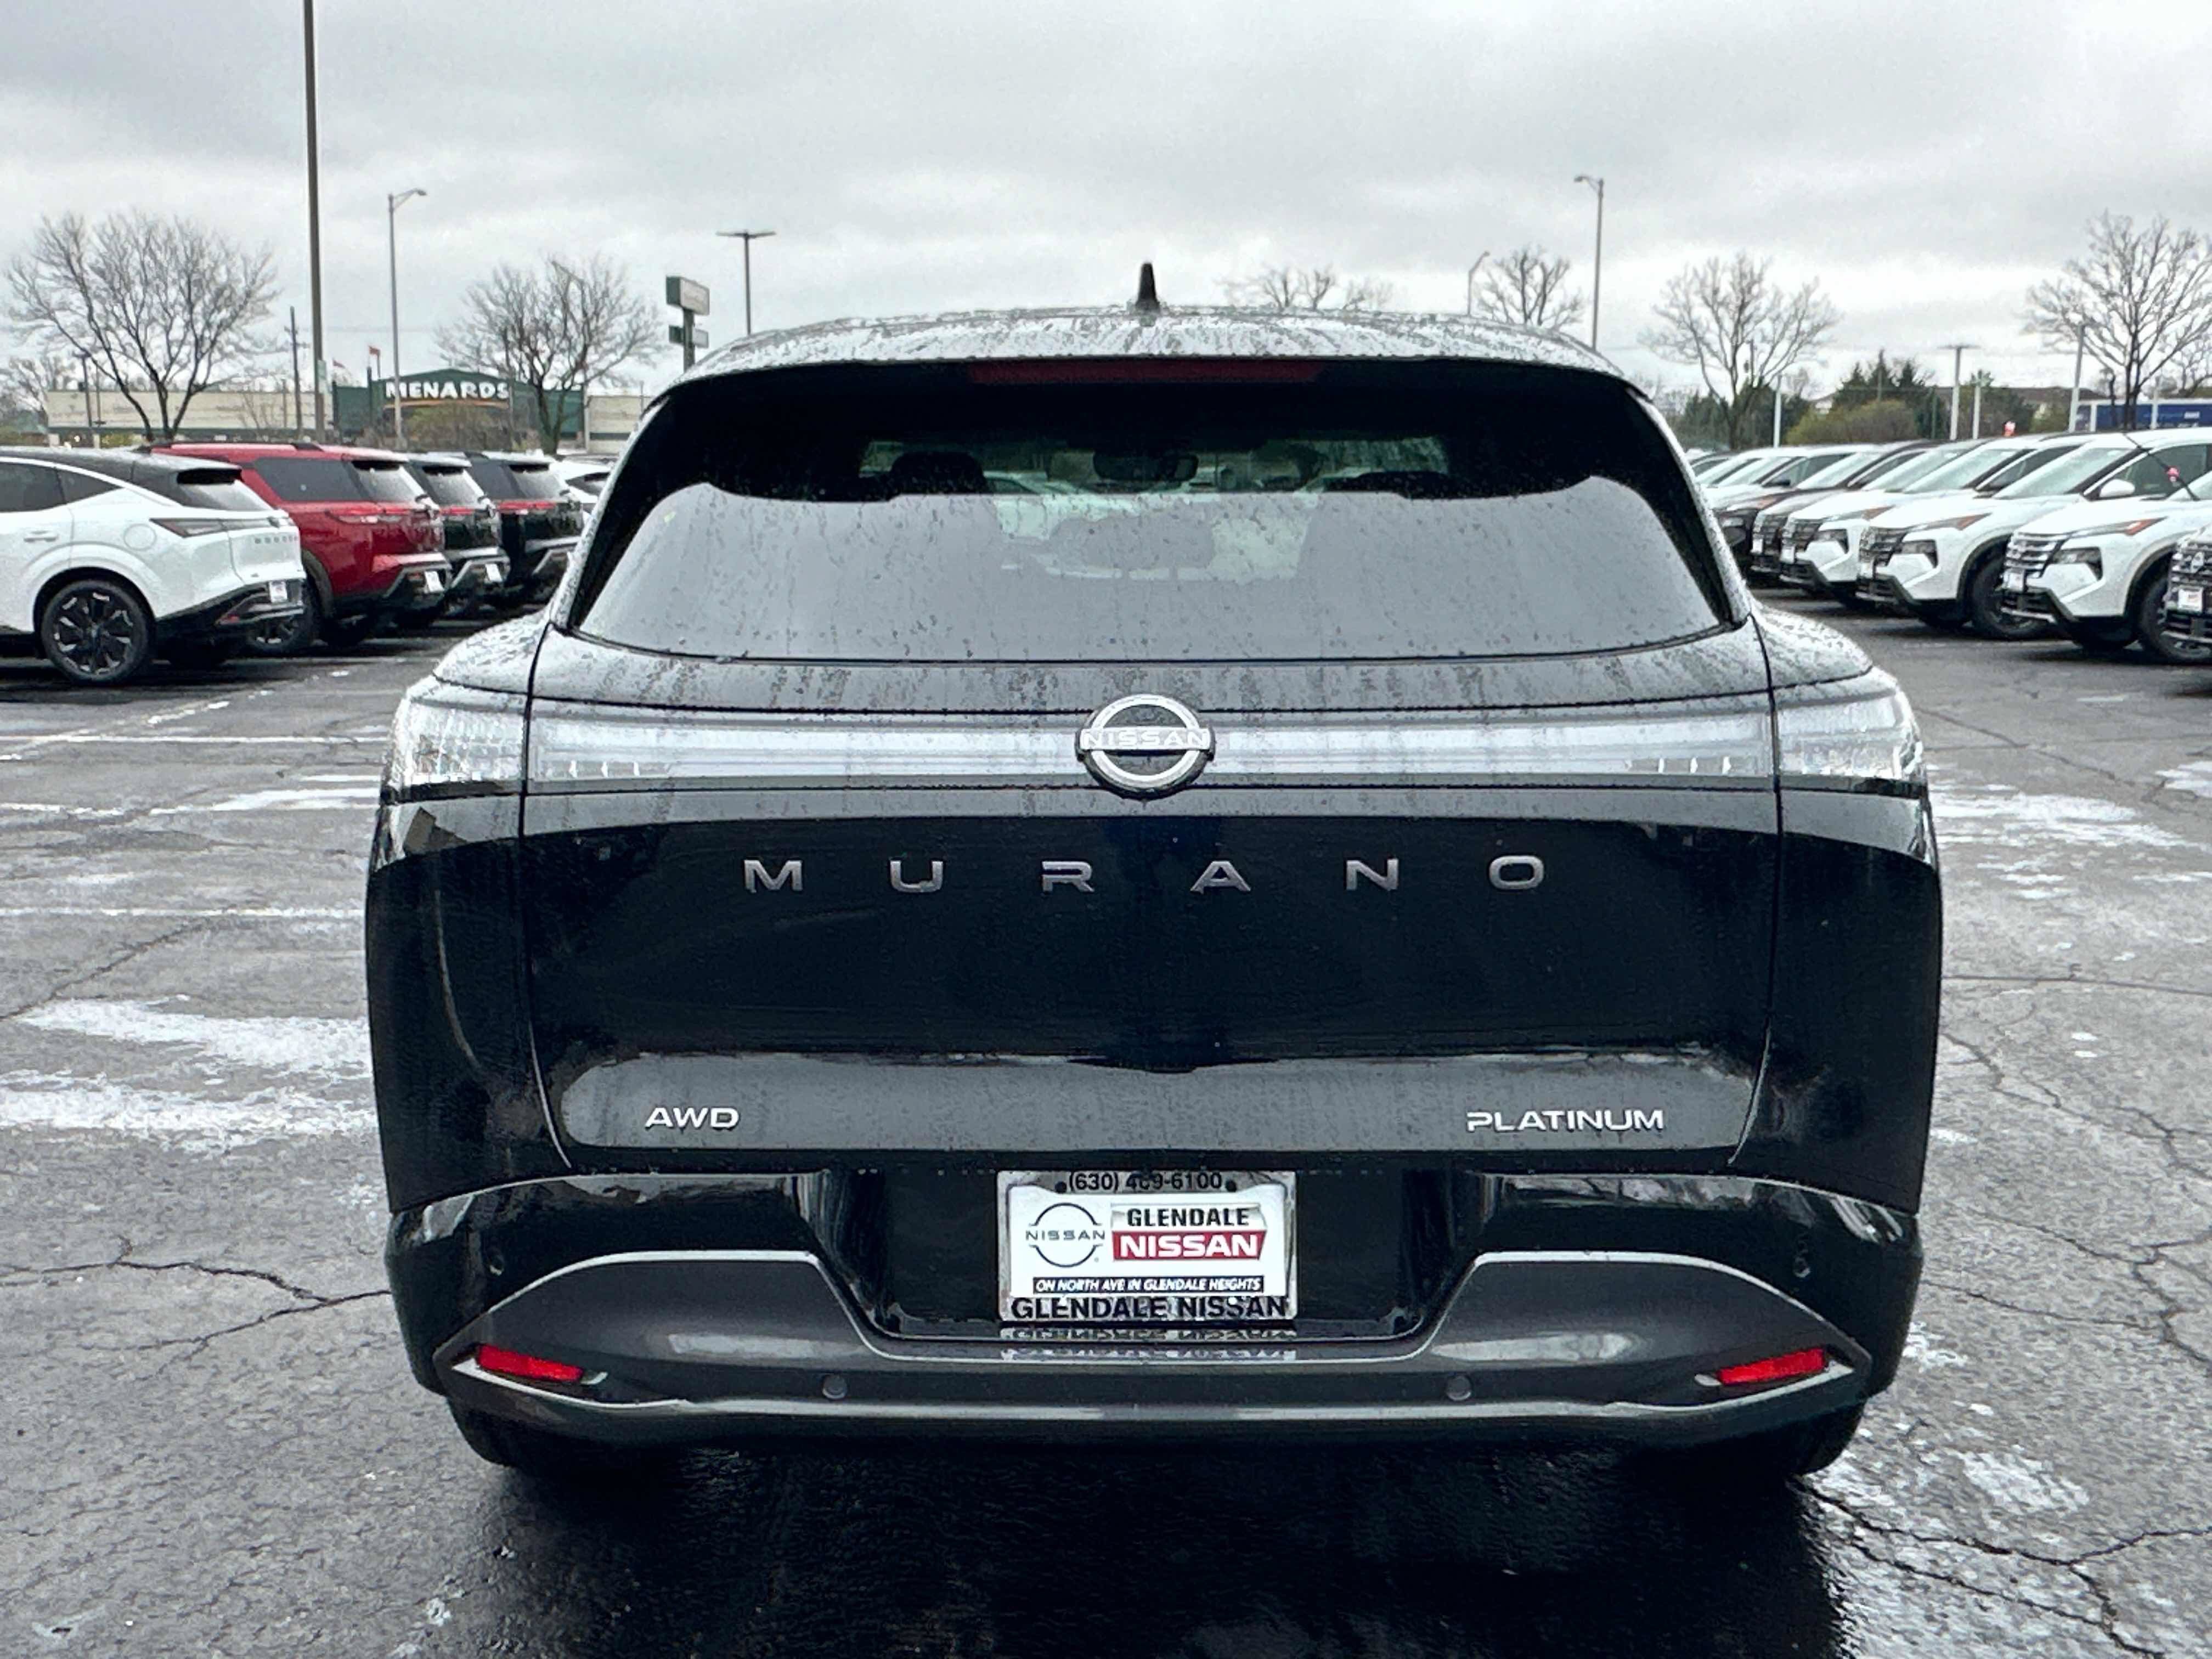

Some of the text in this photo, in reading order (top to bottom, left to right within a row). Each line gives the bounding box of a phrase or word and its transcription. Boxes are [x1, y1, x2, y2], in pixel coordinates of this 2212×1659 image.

[386, 381, 509, 399] MENARDS
[1083, 730, 1207, 747] NISSAN
[743, 855, 1544, 893] MURANO
[645, 1107, 740, 1128] AWD
[1466, 1109, 1664, 1131] PLATINUM
[1070, 1171, 1119, 1192] (630)
[1127, 1207, 1250, 1227] GLENDALE
[1025, 1229, 1105, 1241] NISSAN
[1120, 1234, 1258, 1258] NISSAN
[1036, 1278, 1261, 1291] ON NORTH AVE IN GLENDALE HEIGHTS
[1011, 1296, 1287, 1318] GLENDALE NISSAN
